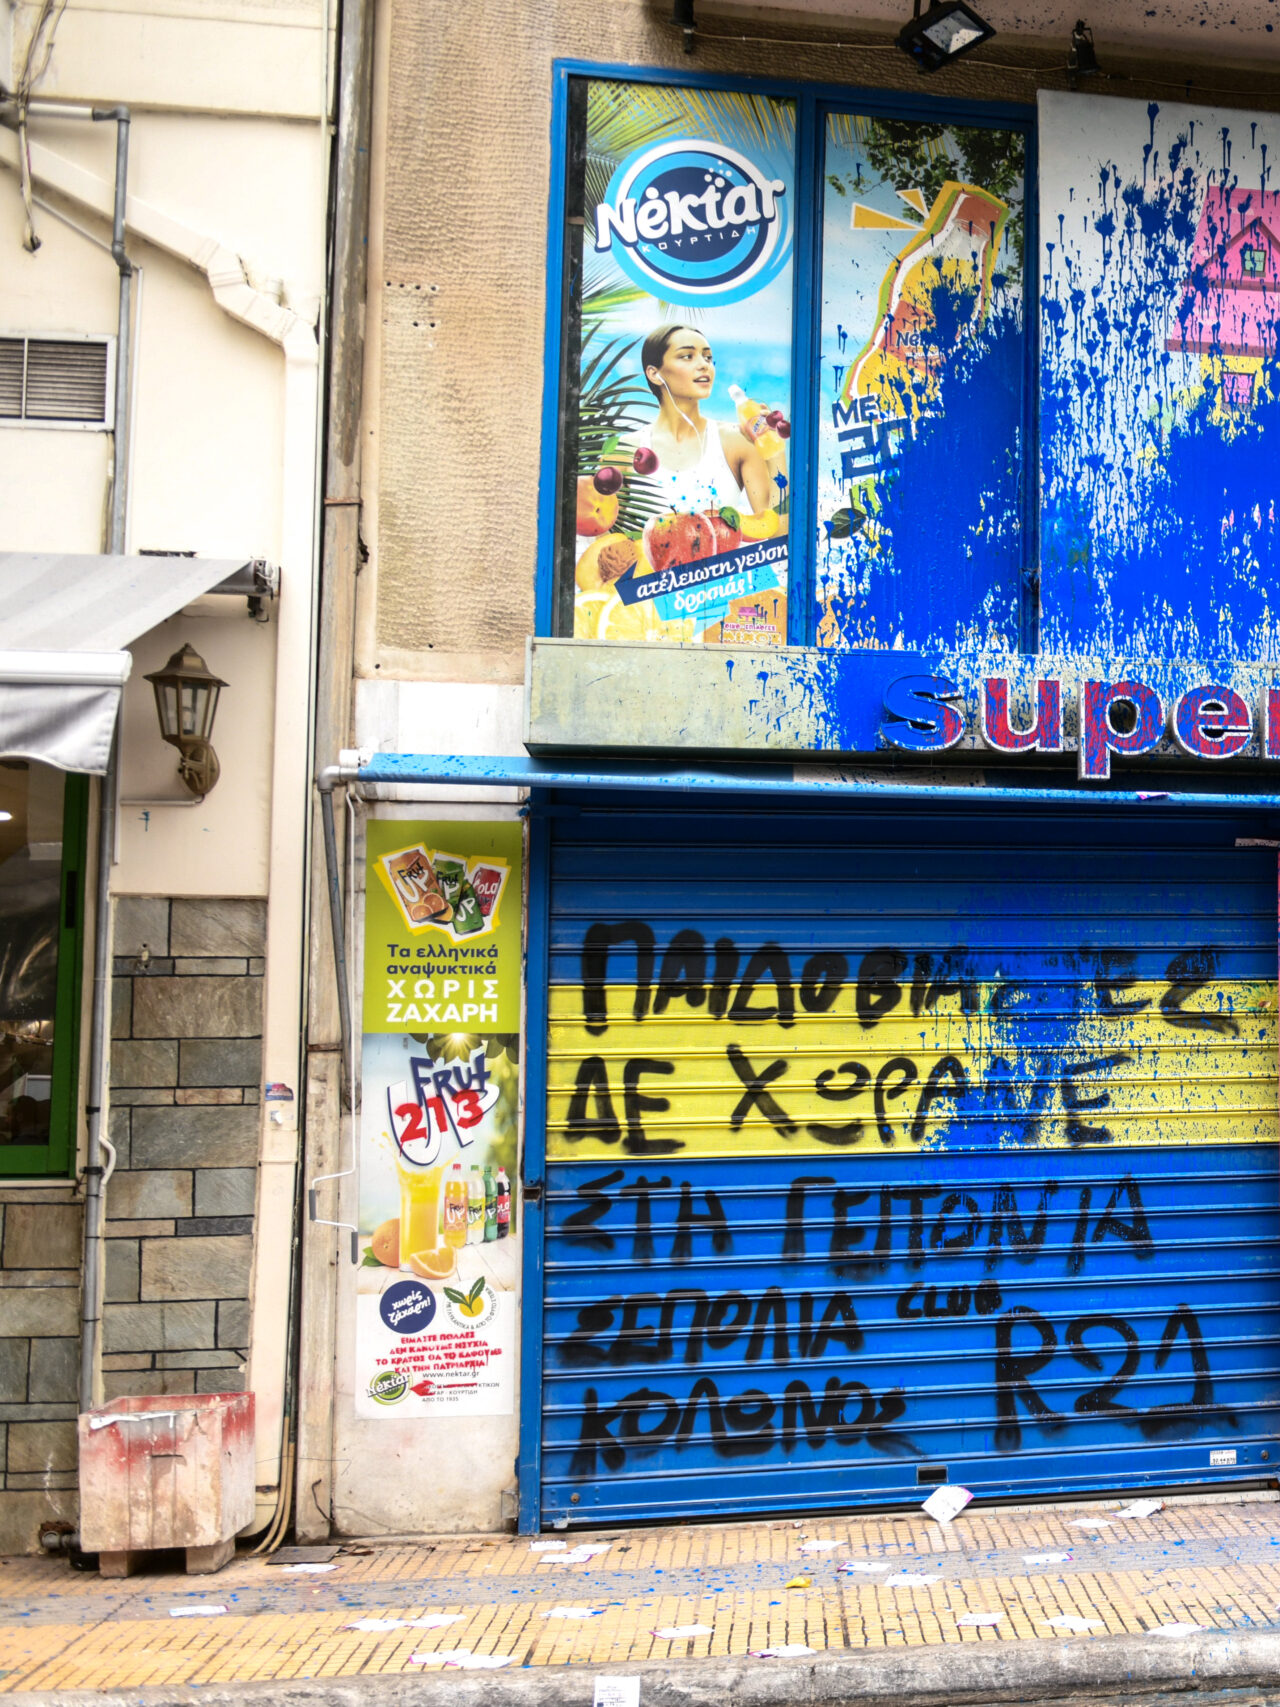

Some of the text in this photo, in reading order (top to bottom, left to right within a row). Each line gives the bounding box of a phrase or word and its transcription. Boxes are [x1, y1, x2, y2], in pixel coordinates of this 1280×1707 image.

[641, 227, 756, 252] ΚΟΥΡΤΙΔΗ
[387, 944, 499, 962] Τα ελληνικά
[386, 961, 497, 978] αναψυκτικά
[386, 979, 499, 999] ΧΩΡΙΣ
[386, 1003, 499, 1023] ΖΑΧΑΡΗ
[565, 1056, 686, 1155] ΔΕ
[394, 1088, 484, 1147] 213
[564, 1168, 734, 1265] ΣΤΗ
[375, 1357, 388, 1366] ΤΟ
[443, 1351, 457, 1361] ΤΟ
[422, 1370, 480, 1379] www.nektar.gr
